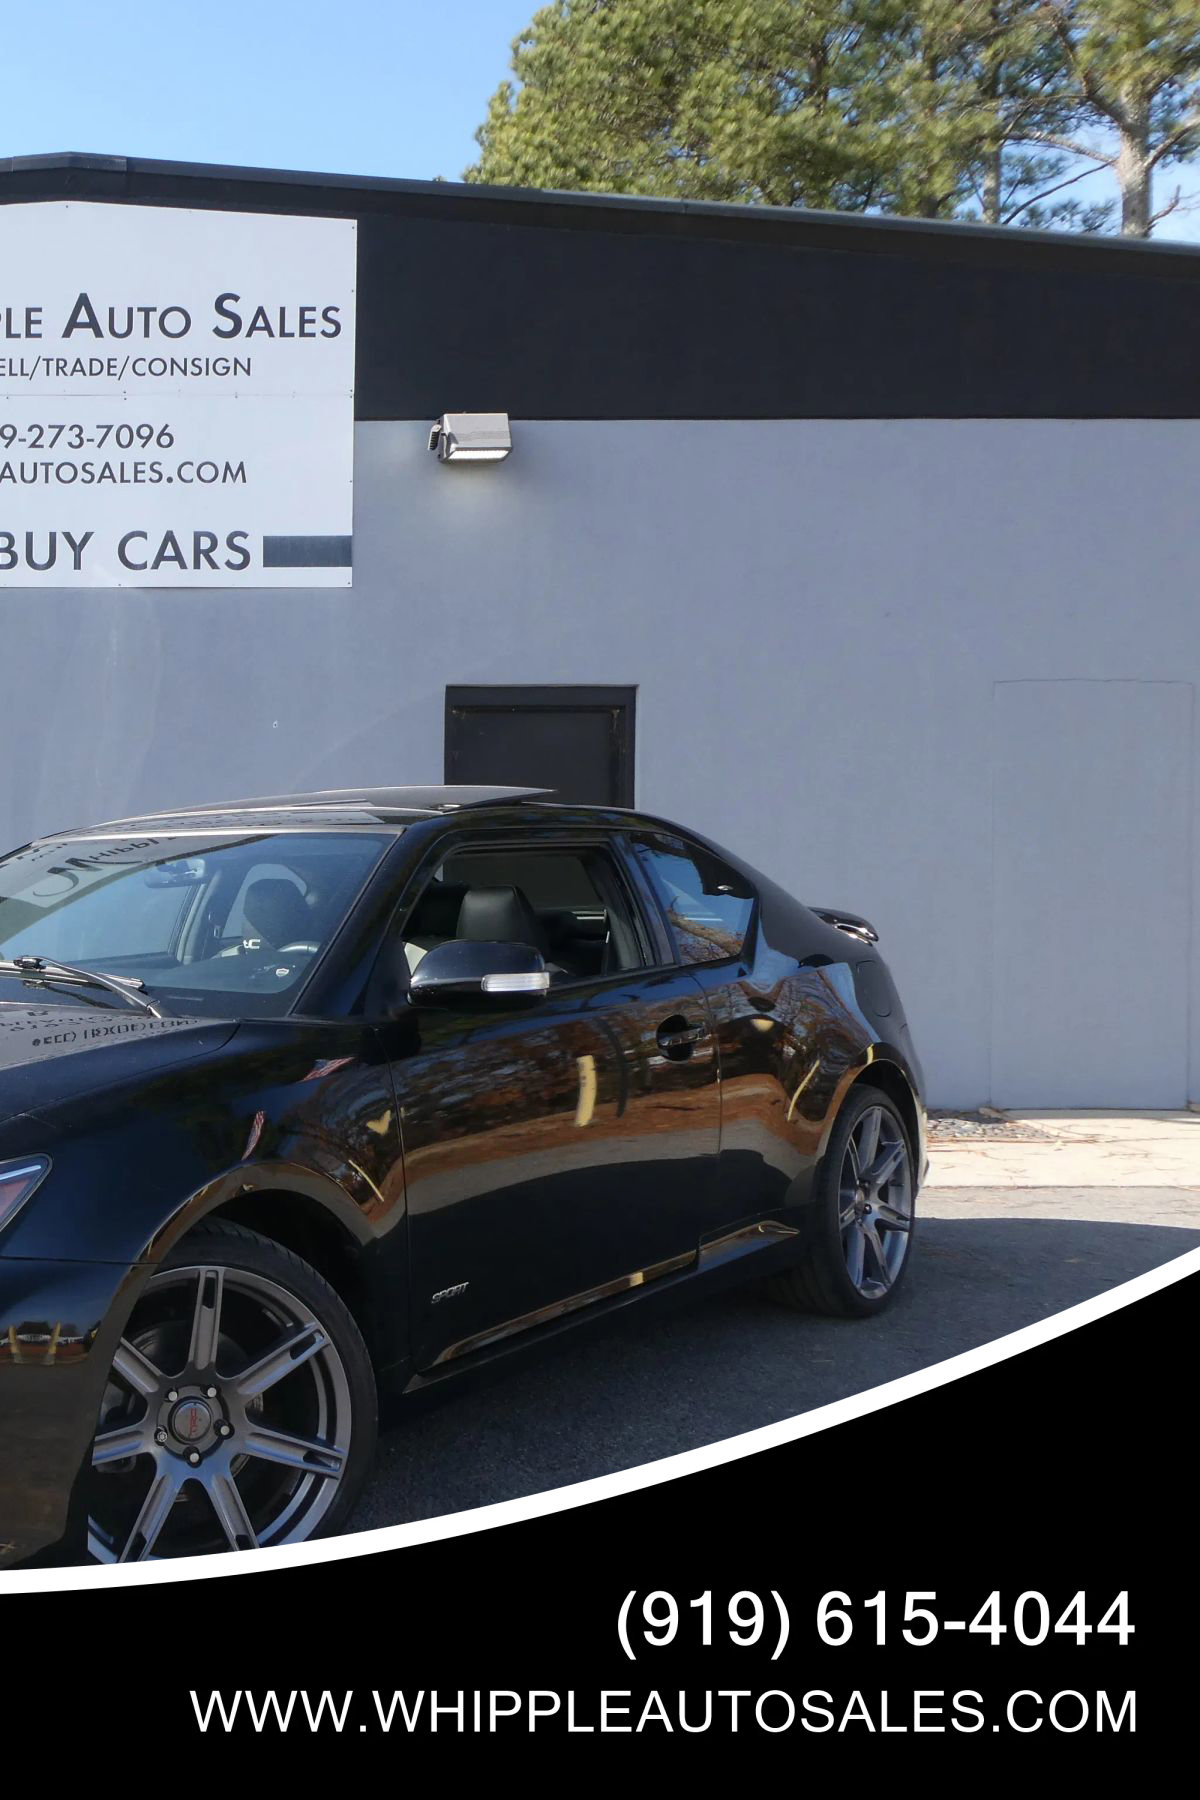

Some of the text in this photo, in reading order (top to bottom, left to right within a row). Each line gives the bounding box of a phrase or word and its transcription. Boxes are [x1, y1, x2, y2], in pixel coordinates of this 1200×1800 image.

[62, 293, 192, 338] AUTO
[213, 293, 342, 338] SALES
[117, 530, 251, 571] CARS
[431, 1281, 469, 1304] SPORT
